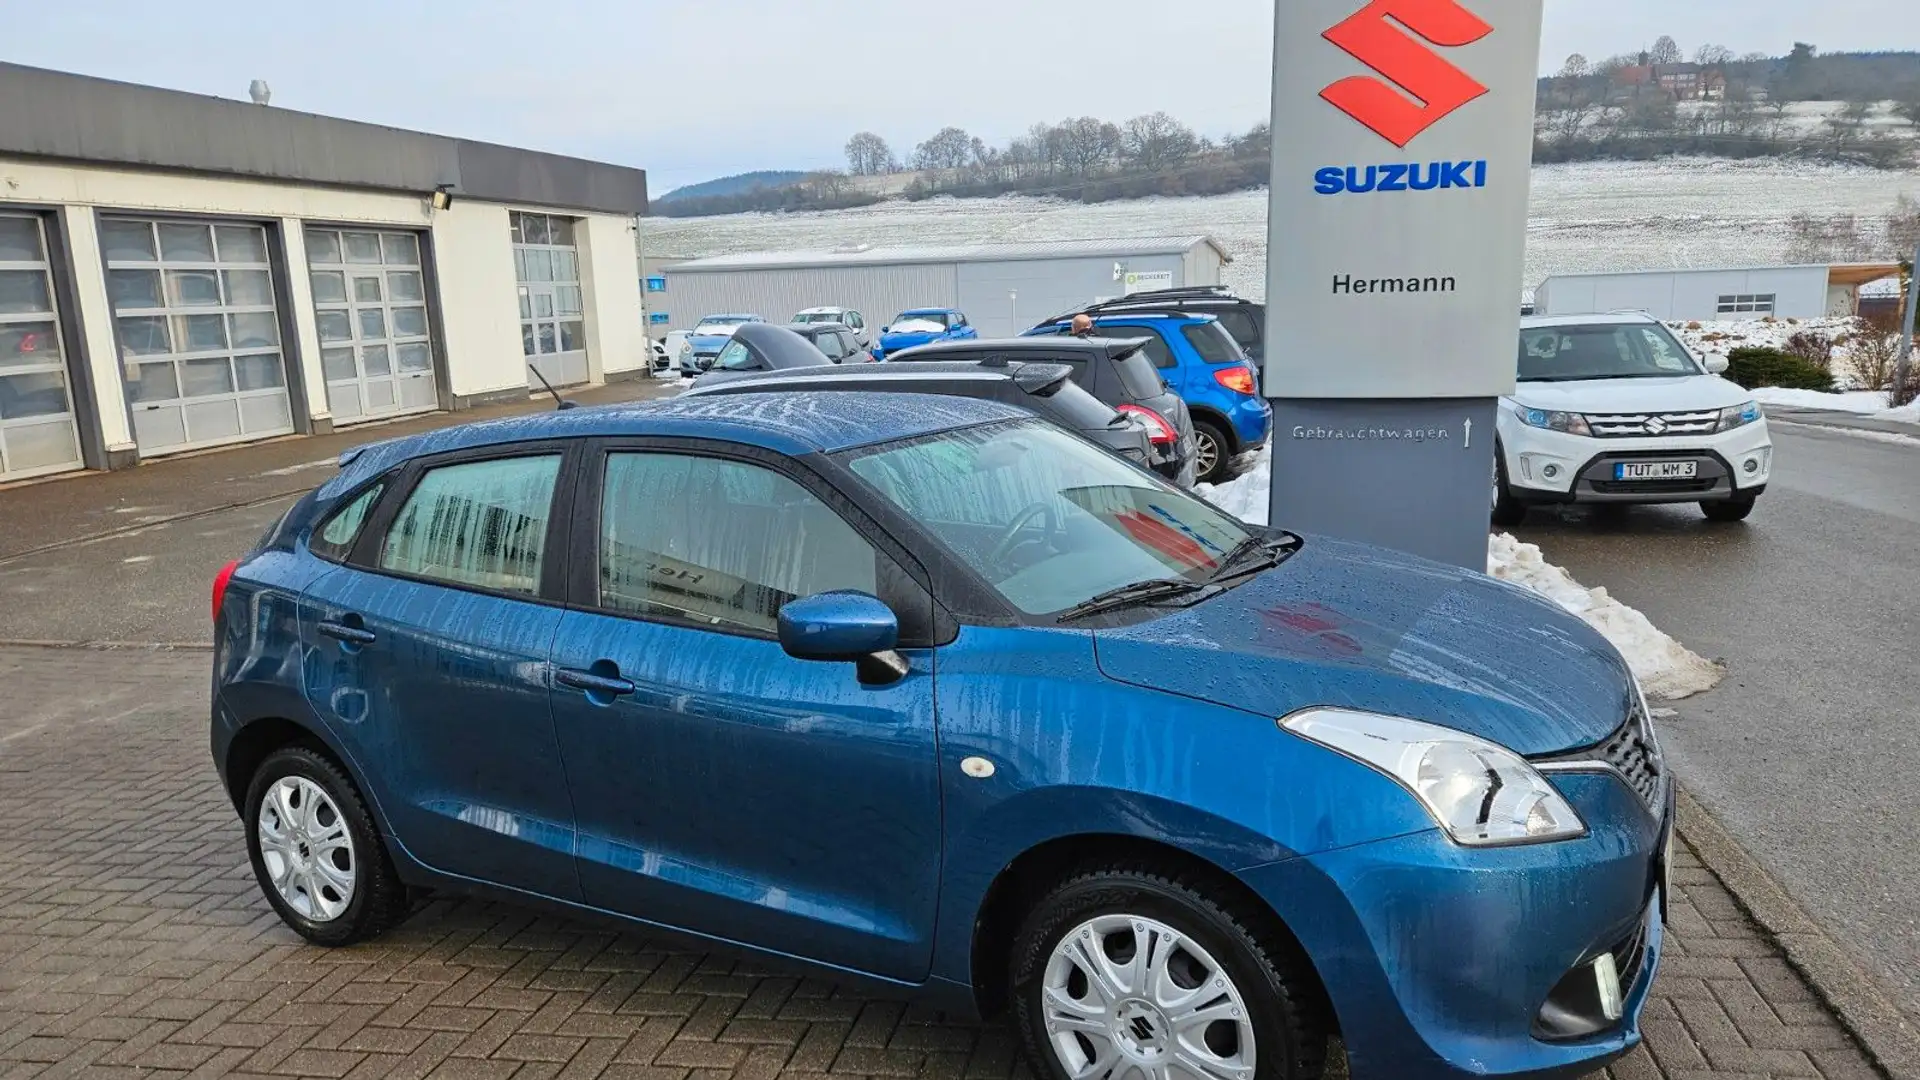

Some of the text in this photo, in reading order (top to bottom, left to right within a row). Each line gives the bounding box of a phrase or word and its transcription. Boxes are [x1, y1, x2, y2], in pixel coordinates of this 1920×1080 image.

[1314, 160, 1487, 195] SUZUKI
[1332, 274, 1456, 295] Hermann
[1292, 425, 1449, 442] Gebrauchtwagen
[1626, 463, 1693, 476] TUT WM 3
